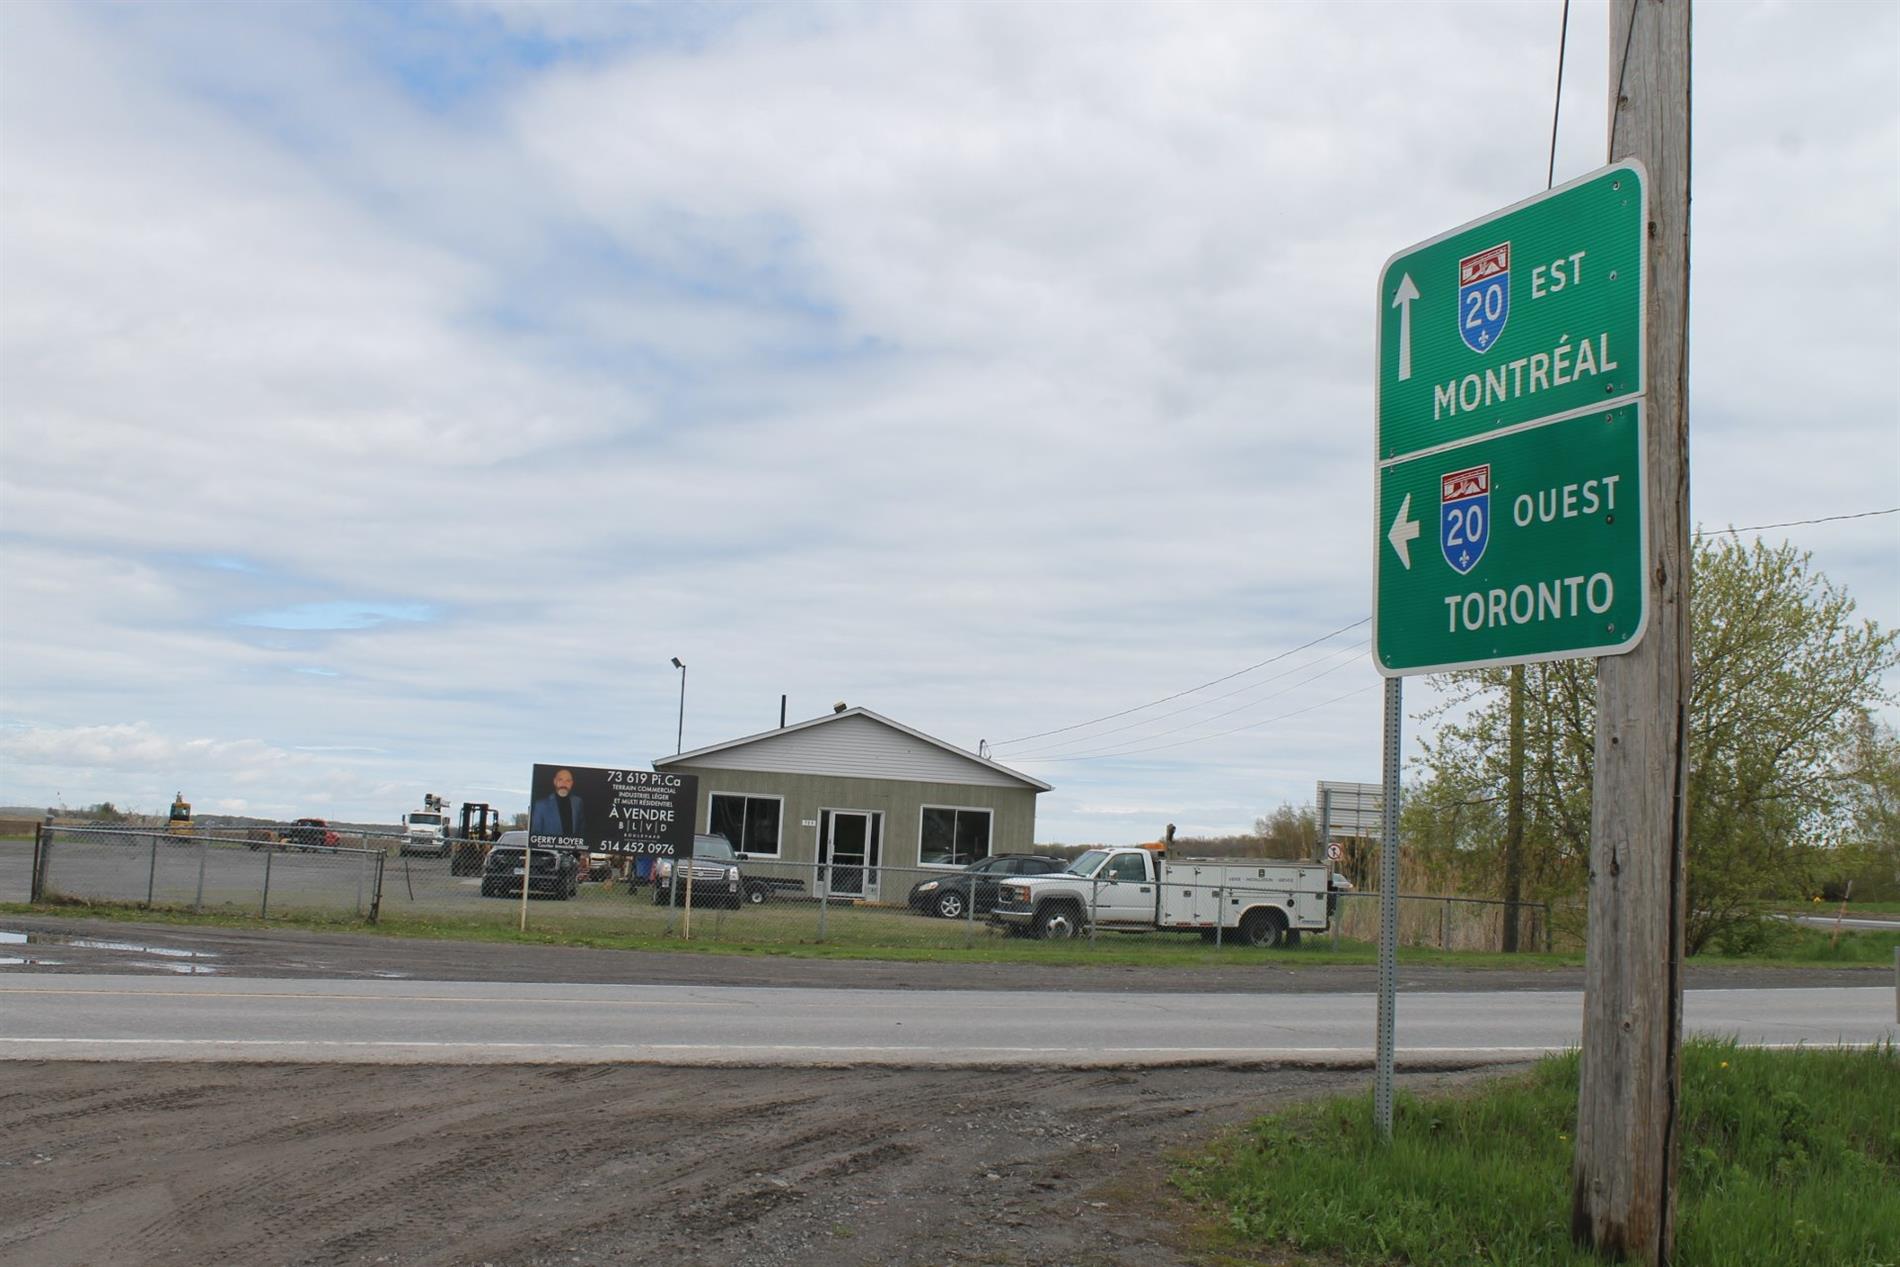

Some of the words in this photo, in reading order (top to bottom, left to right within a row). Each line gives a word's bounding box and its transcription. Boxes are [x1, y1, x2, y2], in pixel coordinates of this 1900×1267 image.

[1465, 284, 1502, 329] 20
[1532, 251, 1586, 299] EST
[1434, 333, 1618, 421] MONTRÉAL
[1447, 504, 1483, 546] 20
[1513, 475, 1620, 527] OUEST
[1444, 572, 1614, 633] TORONTO
[607, 770, 623, 782] 73
[626, 772, 648, 785] 619
[637, 786, 677, 794] COMMERCIAL
[609, 804, 620, 818] À
[623, 807, 675, 822] VENDRE
[530, 835, 557, 844] GERRY
[558, 837, 584, 846] BOYER
[600, 840, 620, 851] 514
[623, 842, 645, 853] 452
[647, 843, 675, 855] 0976
